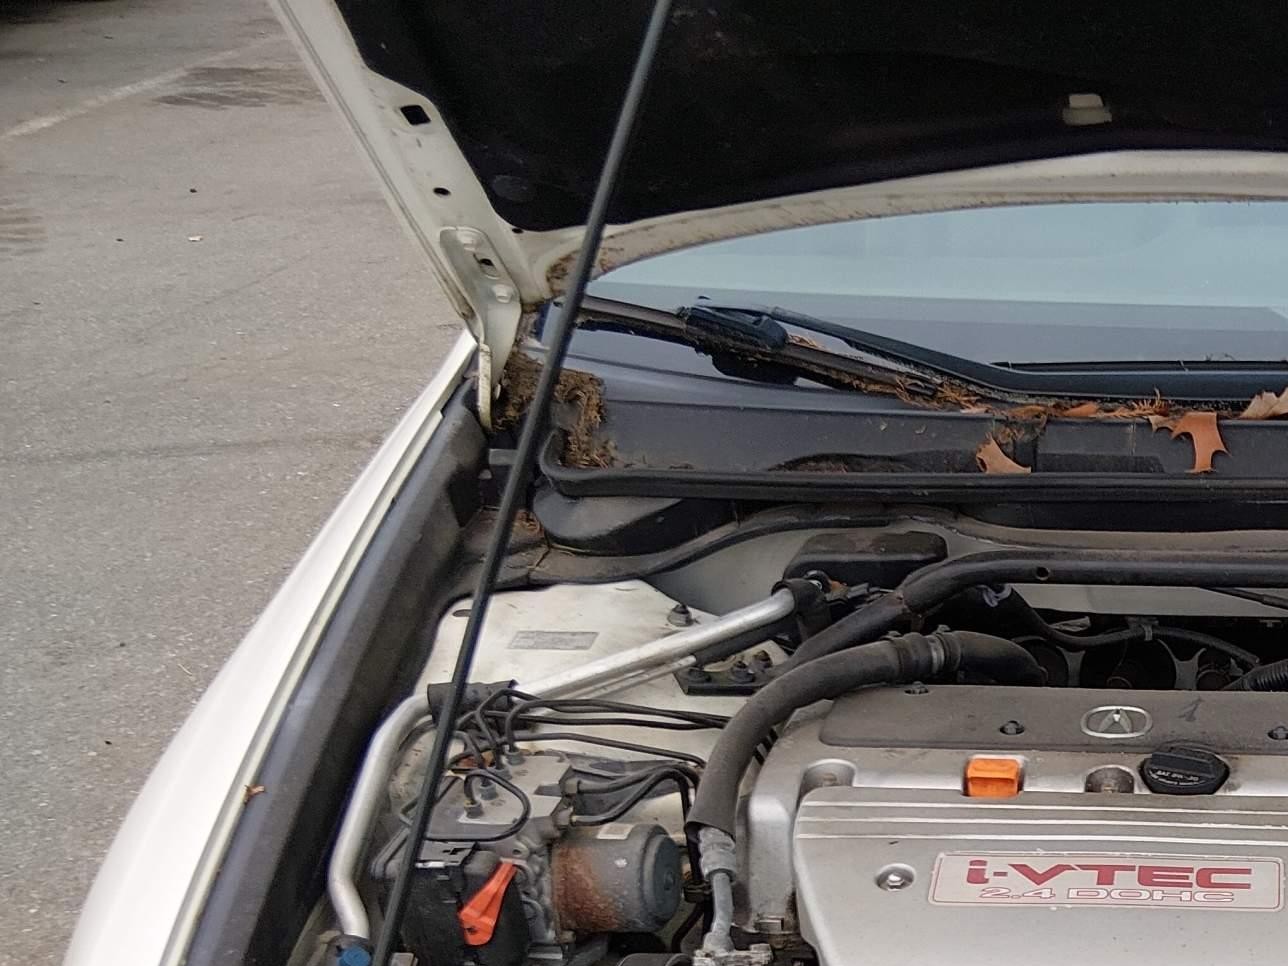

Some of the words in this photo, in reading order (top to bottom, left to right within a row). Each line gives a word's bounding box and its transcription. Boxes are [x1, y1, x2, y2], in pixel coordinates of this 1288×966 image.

[966, 859, 1252, 889] i-VTEC
[980, 888, 1056, 899] 2.4
[1067, 888, 1235, 902] DOHC
